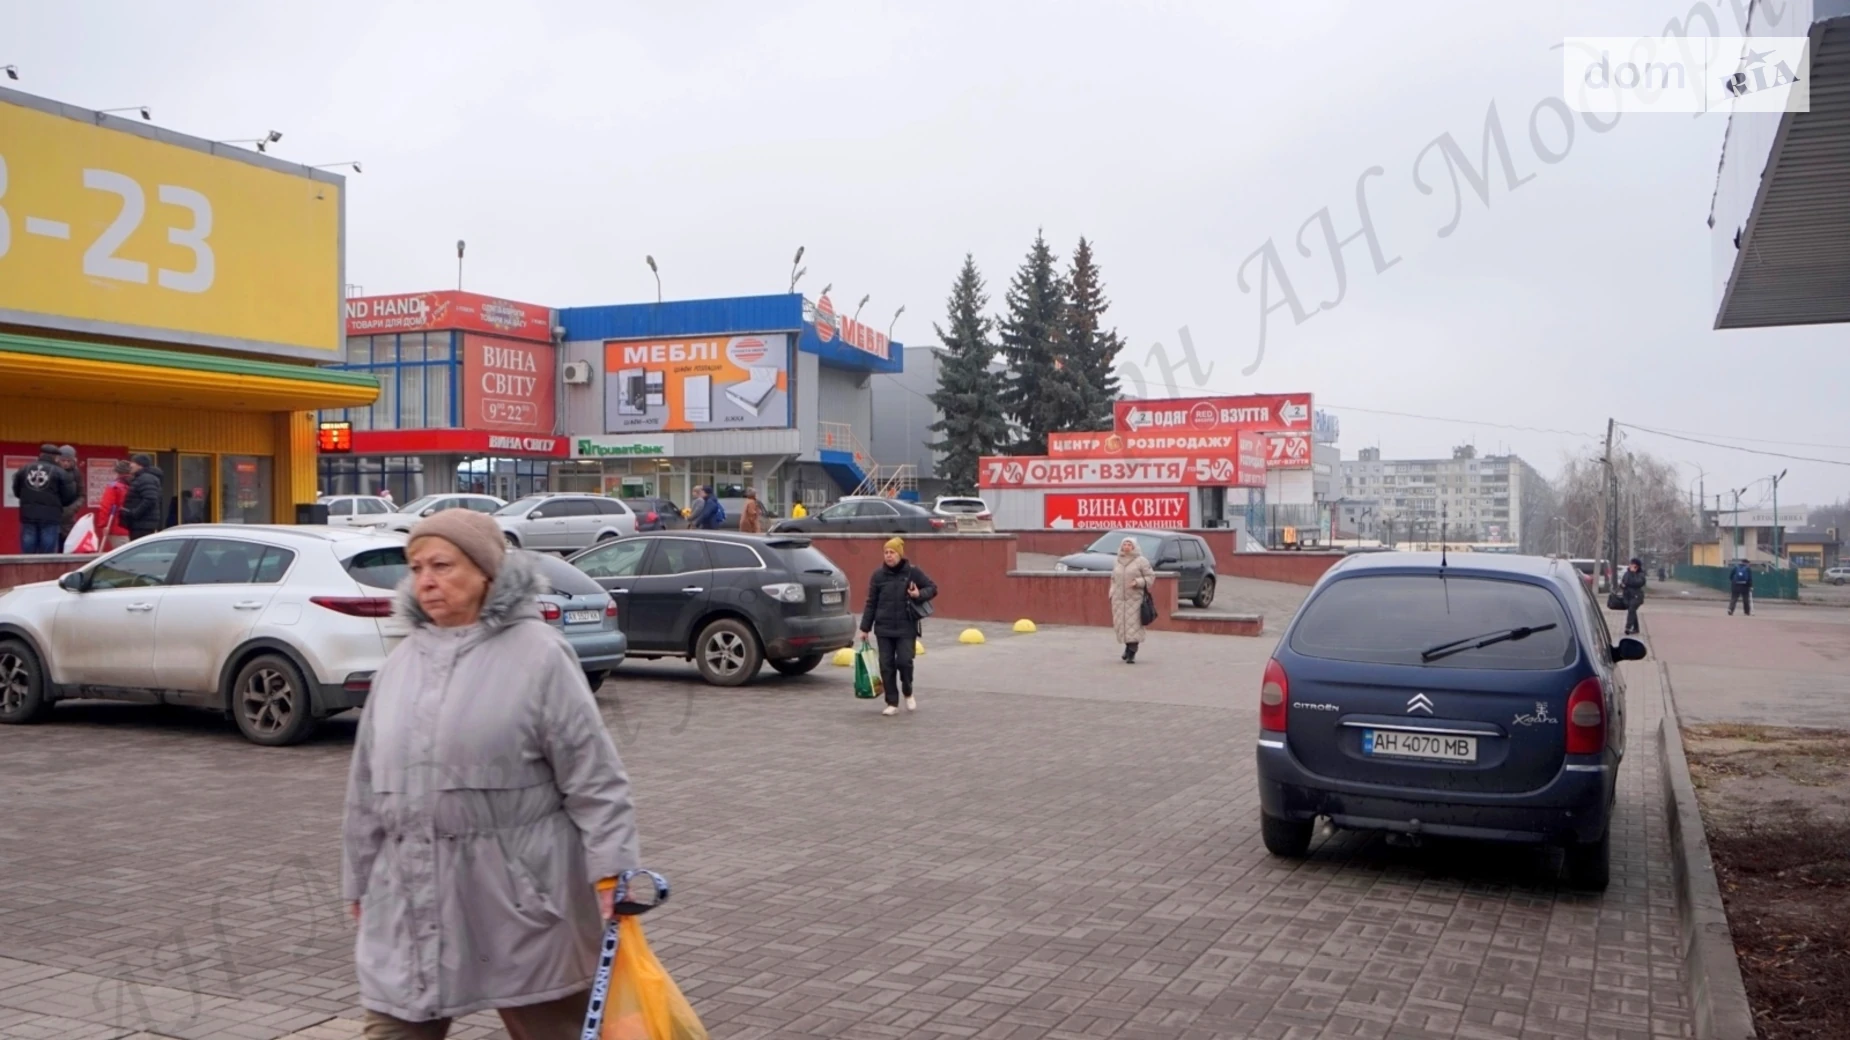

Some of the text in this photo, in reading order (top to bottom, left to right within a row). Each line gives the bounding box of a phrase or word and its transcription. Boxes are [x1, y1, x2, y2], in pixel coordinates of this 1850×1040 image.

[352, 320, 383, 329] ТОВАРИ
[385, 319, 401, 328] ДЛЯ
[483, 345, 537, 372] ВИНА
[623, 342, 718, 364] МЕБЛІ
[481, 372, 537, 397] СВІТУ
[1154, 410, 1188, 427] ОДЯГ
[1220, 407, 1269, 423] ВЗУТТЯ
[489, 435, 556, 452] ВИНА СВІТУ
[591, 443, 664, 456] ПриватБанк
[1053, 439, 1100, 453] ЦЕНТР
[1127, 436, 1232, 450] РОЗПРОДАЖУ
[1077, 498, 1185, 517] ВИНА СВІТУ
[1077, 519, 1183, 529] ФІРМОВА КРАМНИЦЯ
[1293, 702, 1340, 712] CITROËN
[1374, 733, 1470, 756] AH 4070 MB
